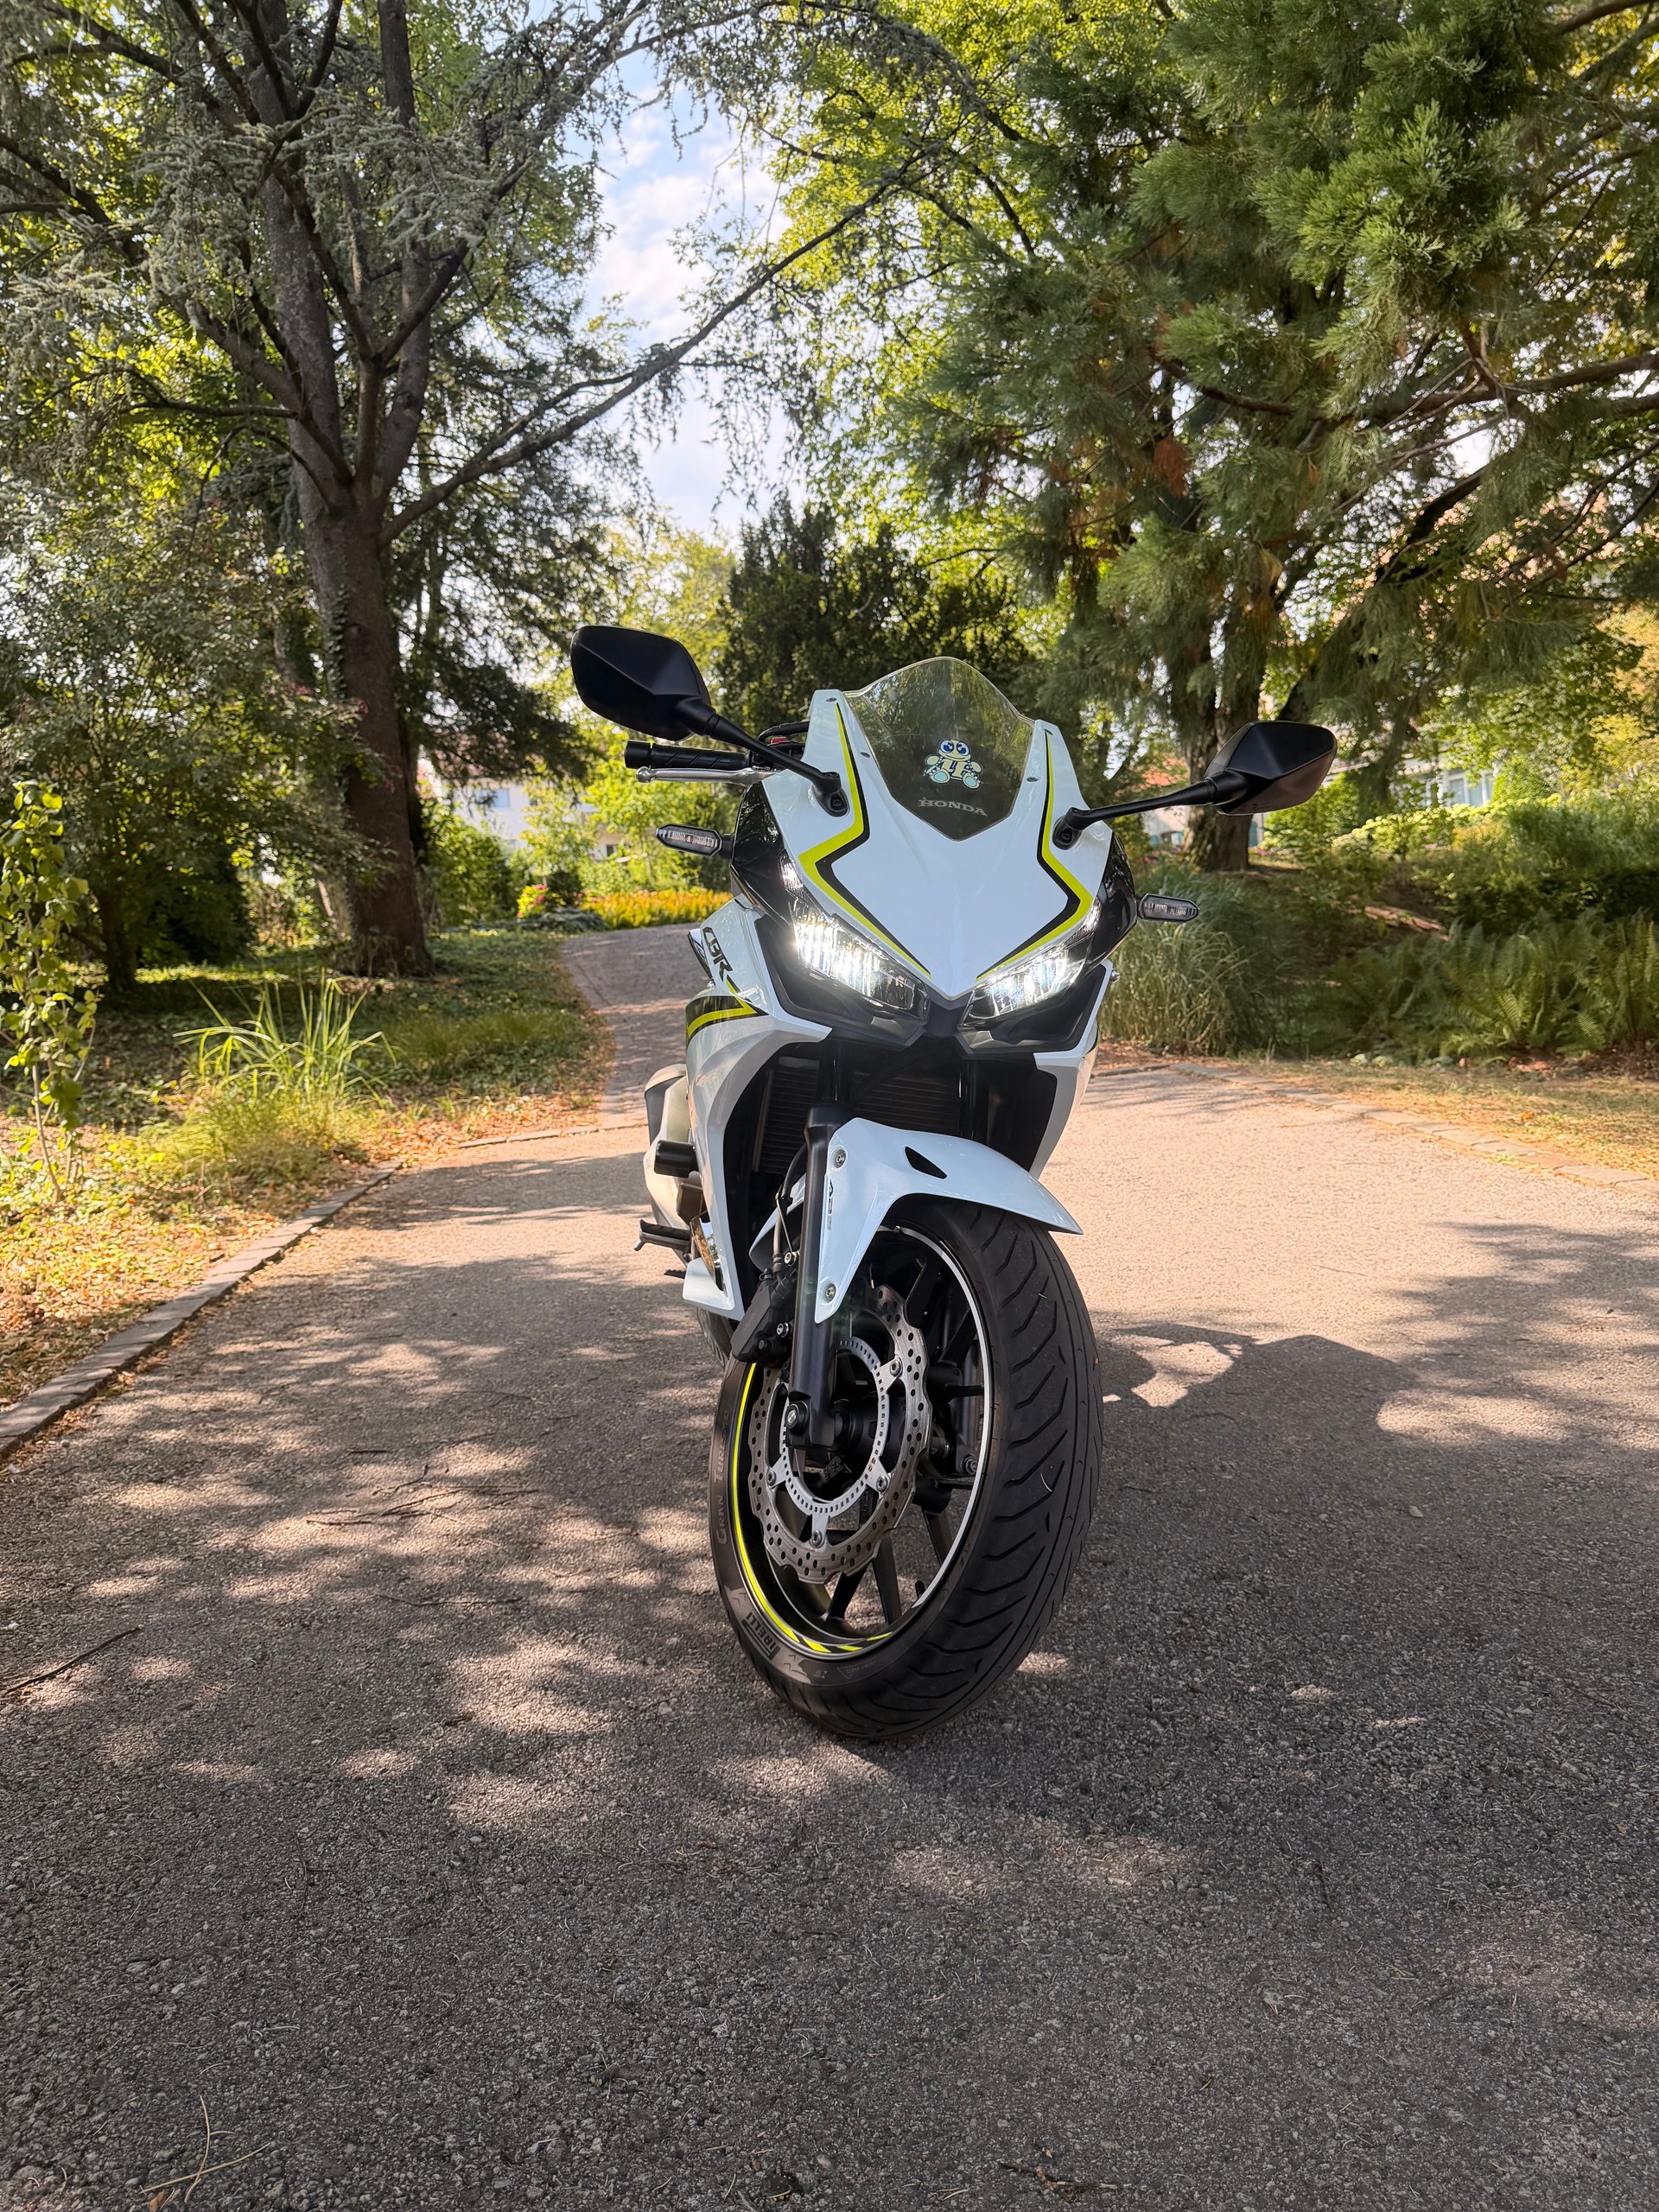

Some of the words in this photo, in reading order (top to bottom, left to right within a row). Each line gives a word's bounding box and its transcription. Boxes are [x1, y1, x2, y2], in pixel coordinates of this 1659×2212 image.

[918, 797, 988, 817] HONDA
[702, 926, 734, 982] CBR
[715, 1409, 731, 1484] TURISMO
[715, 1495, 728, 1545] GRAN
[741, 1611, 781, 1661] PIRELLI
